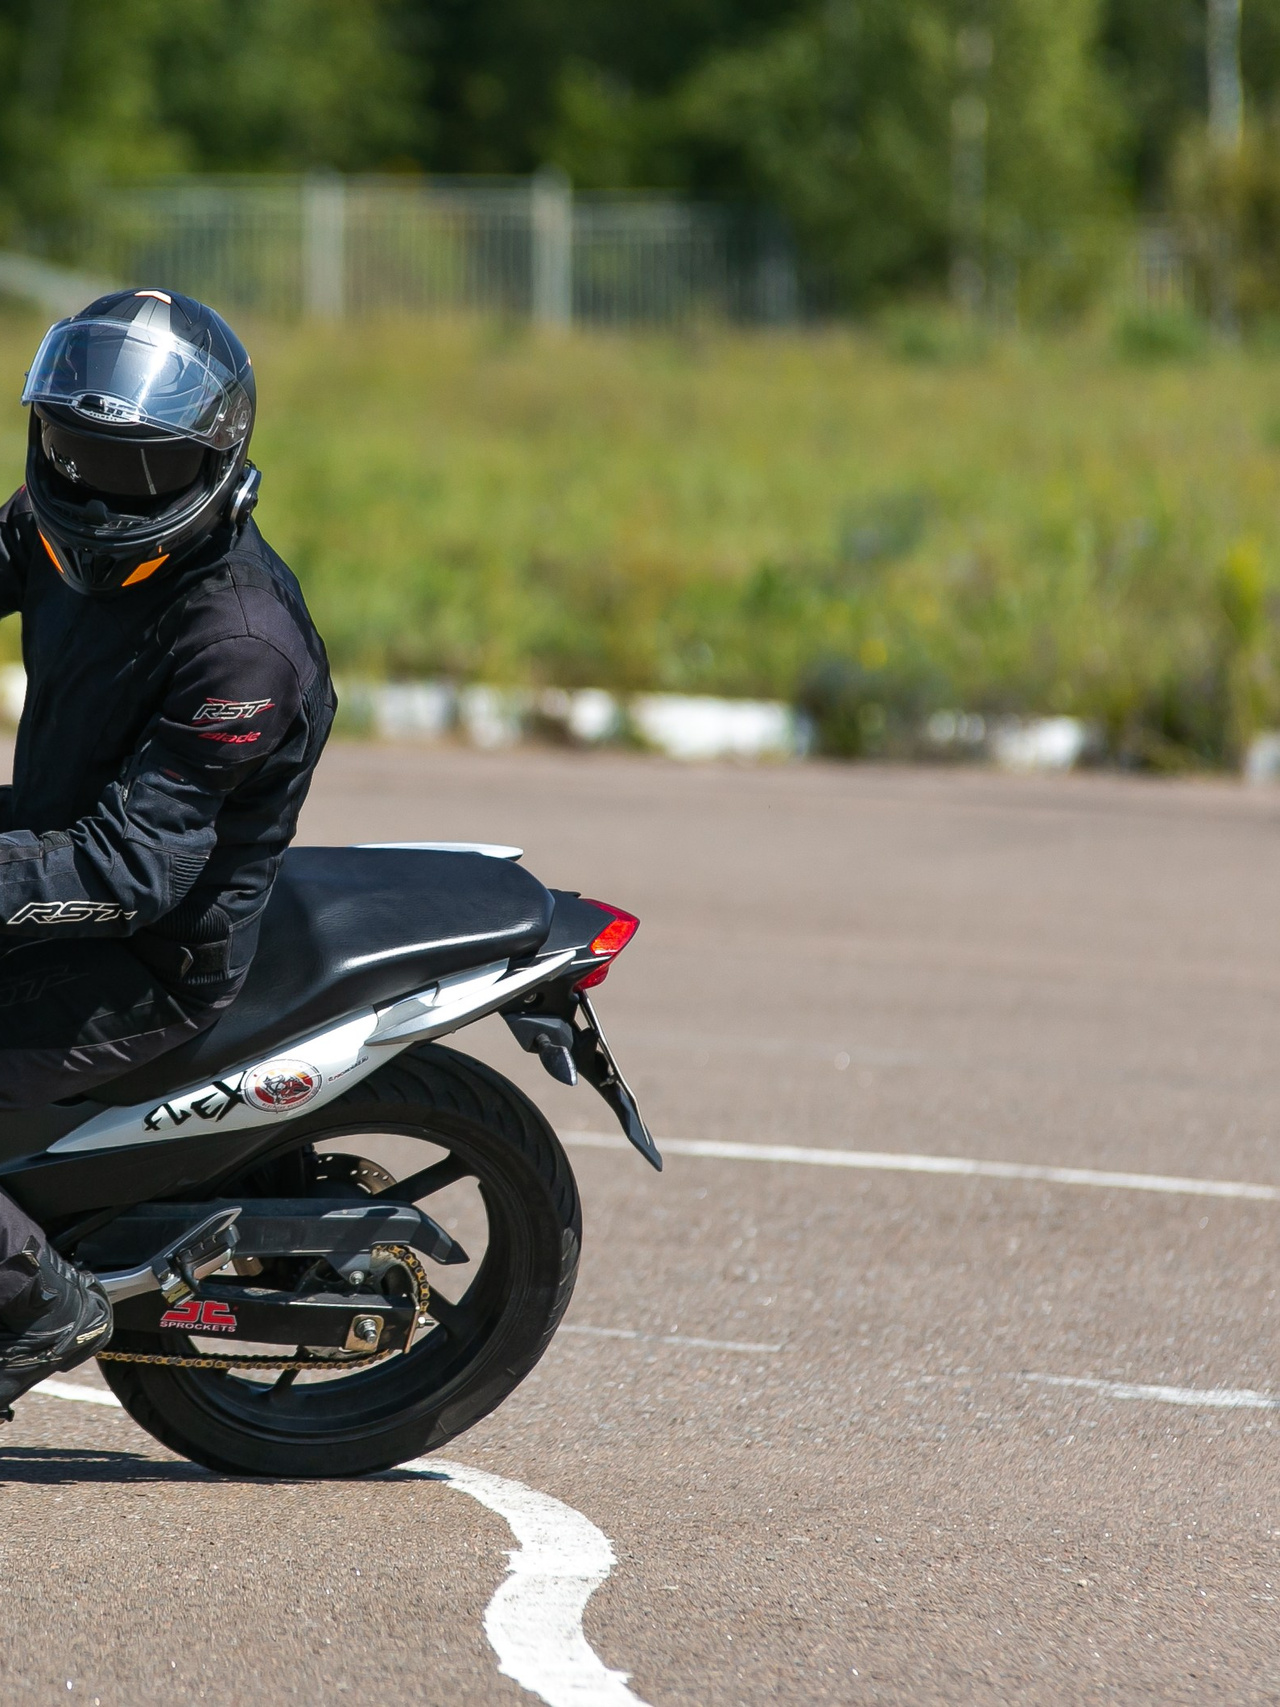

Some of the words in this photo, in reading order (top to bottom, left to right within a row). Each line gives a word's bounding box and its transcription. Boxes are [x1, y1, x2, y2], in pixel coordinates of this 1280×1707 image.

[192, 698, 271, 720] RST
[144, 1071, 246, 1132] FLEX
[160, 1321, 236, 1332] SPROCKETS
